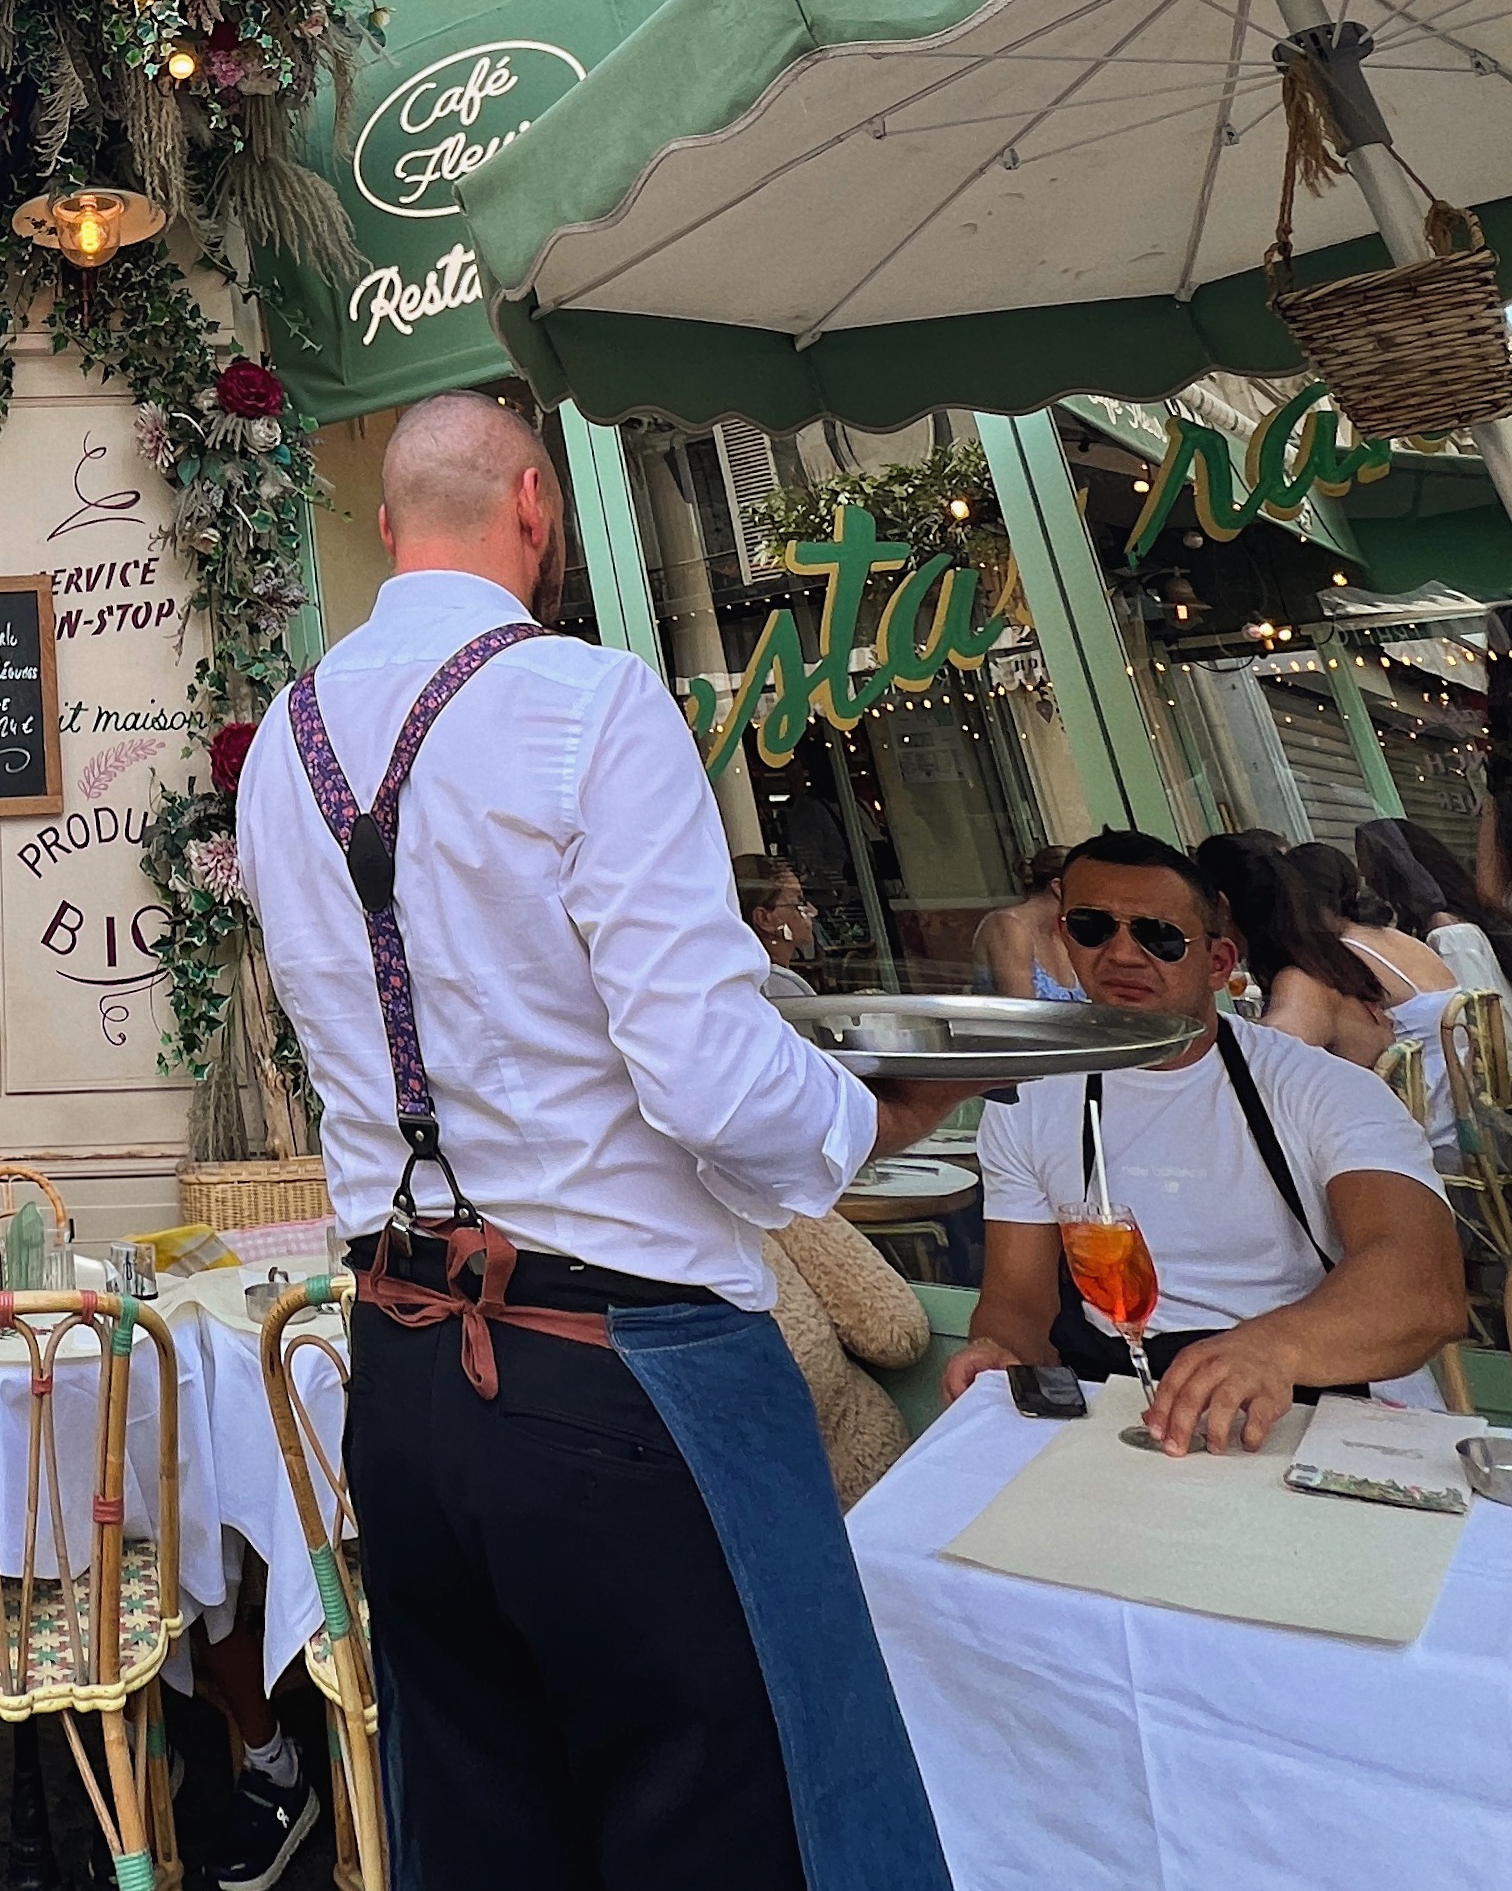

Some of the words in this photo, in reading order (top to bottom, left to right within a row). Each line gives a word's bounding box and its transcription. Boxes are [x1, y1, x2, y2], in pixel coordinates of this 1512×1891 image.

[399, 55, 519, 134] Café
[39, 556, 160, 596] ERVICE
[53, 598, 176, 641] N-STOP
[92, 698, 208, 734] maison
[40, 899, 175, 968] BIO
